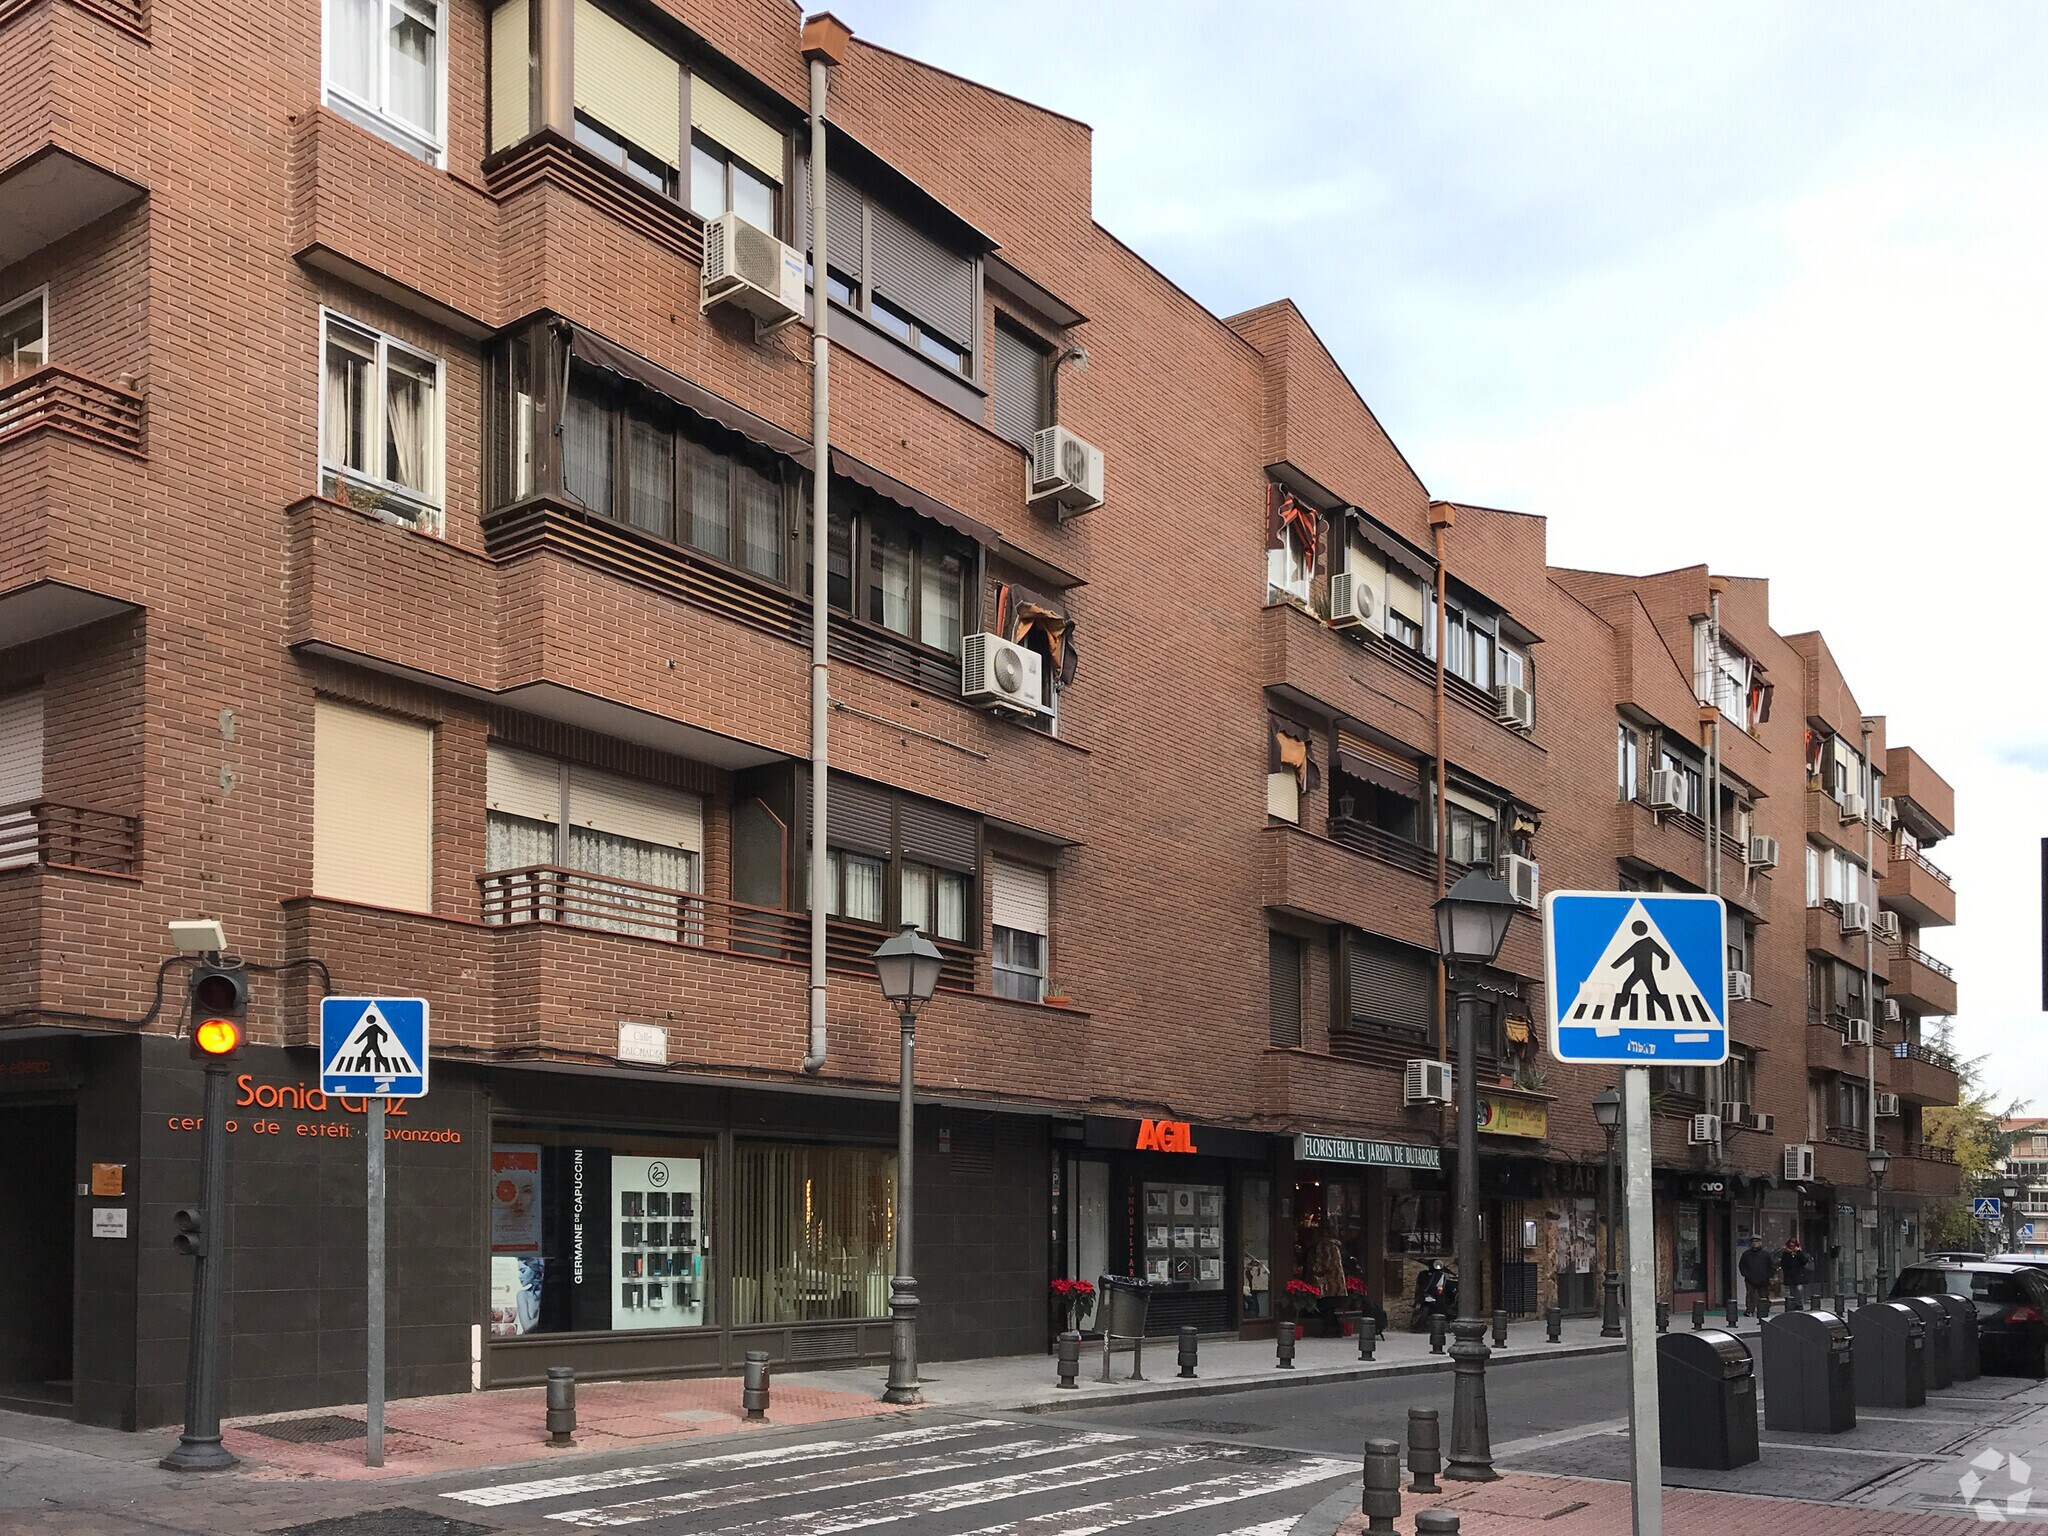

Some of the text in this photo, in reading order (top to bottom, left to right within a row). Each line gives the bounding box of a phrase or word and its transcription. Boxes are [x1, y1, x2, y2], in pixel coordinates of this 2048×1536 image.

[633, 1031, 653, 1041] Calle
[236, 1074, 327, 1111] Sonia
[253, 1119, 280, 1134] de
[1305, 1137, 1439, 1166] FLORISTERIA EL JARDIN DE BUTARQUE
[574, 1149, 583, 1284] GERMAINE DE CAPUCCINI
